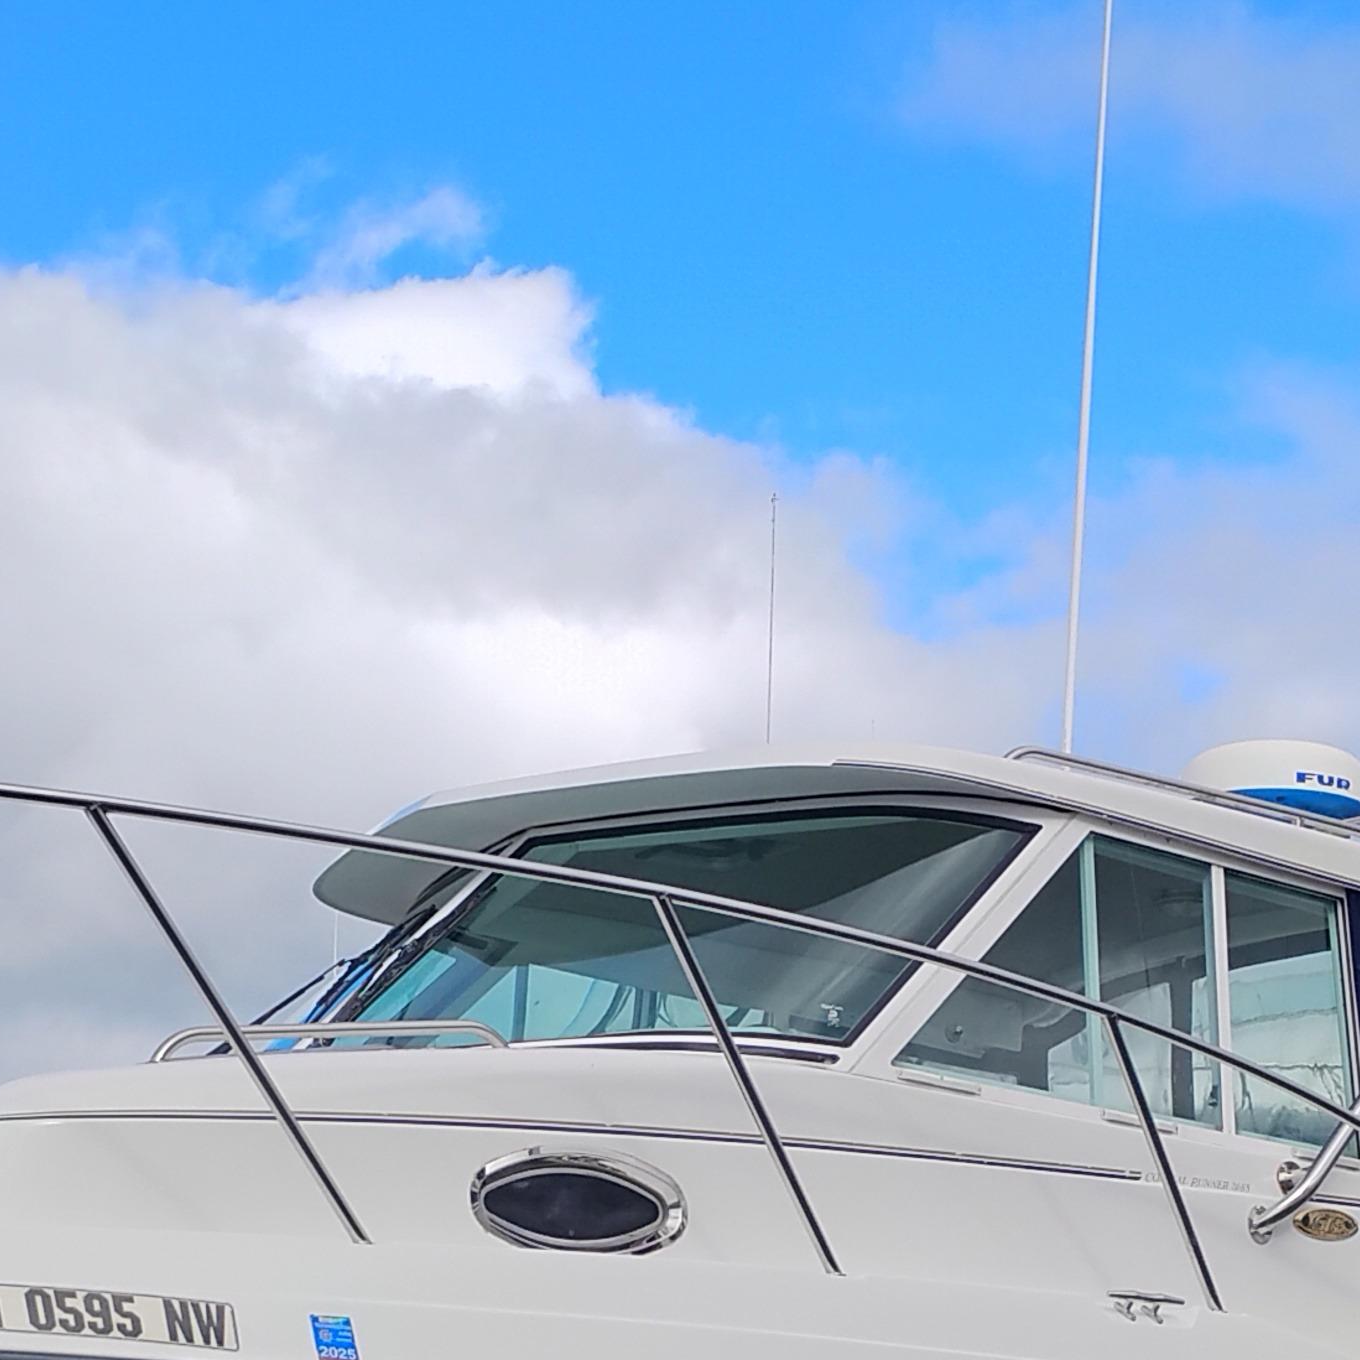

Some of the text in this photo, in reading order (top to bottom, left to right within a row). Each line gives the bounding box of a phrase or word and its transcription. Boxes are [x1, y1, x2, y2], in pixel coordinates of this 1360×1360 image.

[24, 1287, 144, 1339] 0595
[161, 1298, 227, 1347] NW
[319, 1345, 357, 1360] 2025
